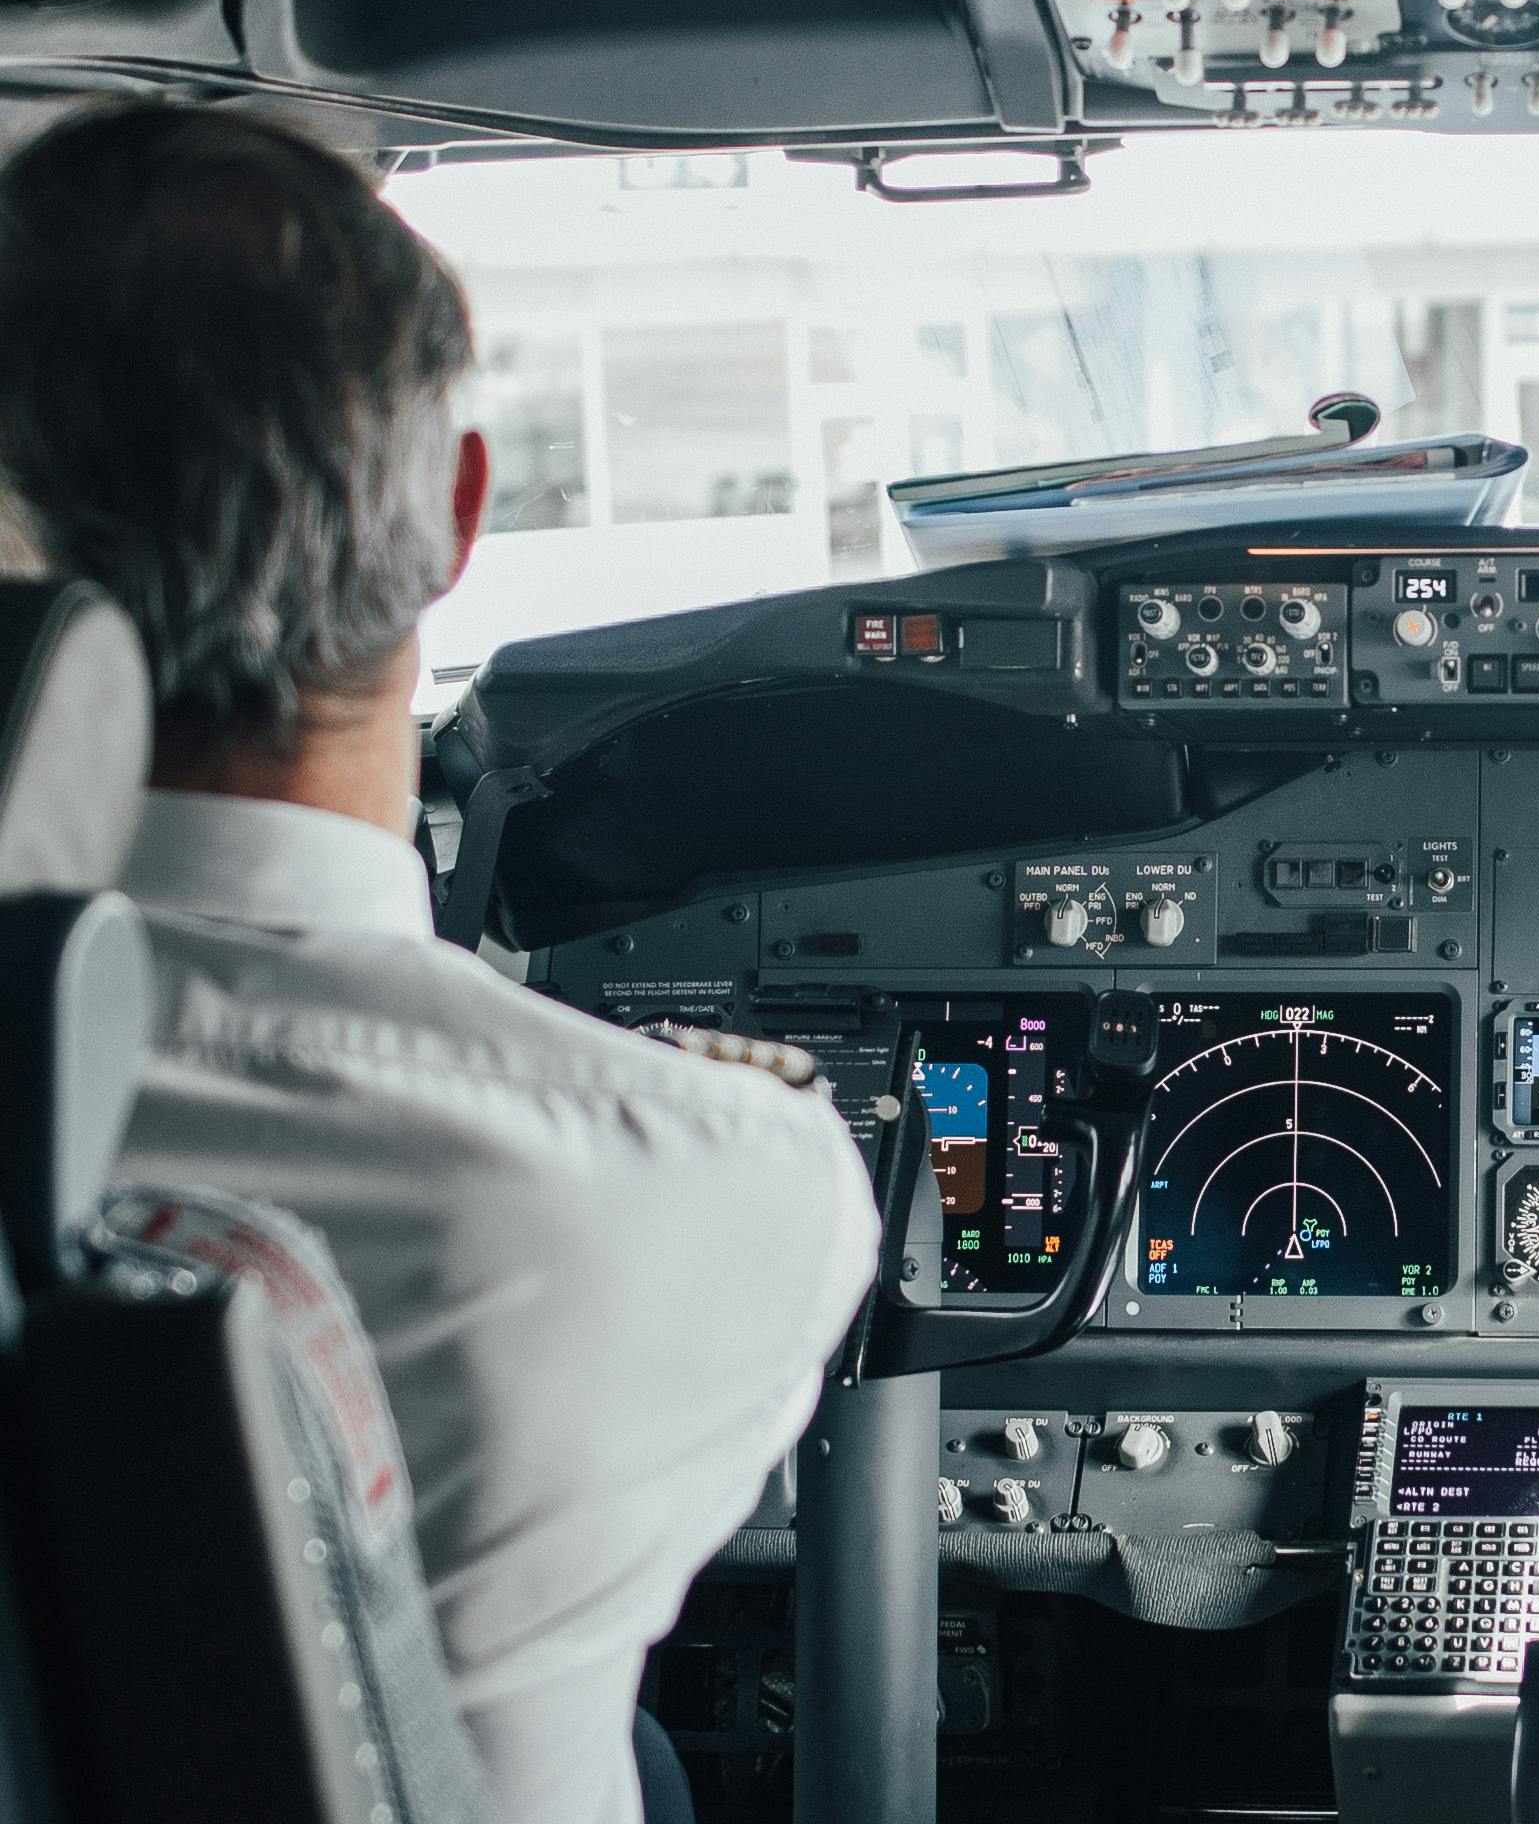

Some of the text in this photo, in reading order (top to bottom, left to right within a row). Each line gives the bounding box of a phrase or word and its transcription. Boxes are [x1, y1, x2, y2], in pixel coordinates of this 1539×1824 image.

[1406, 578, 1447, 599] 254
[865, 619, 885, 629] FIRE
[1423, 841, 1458, 851] LIGHTS
[1431, 854, 1449, 862] TEST
[1026, 866, 1051, 876] MAIN
[1053, 866, 1088, 876] PANEL
[1136, 865, 1192, 876] LOWER DU
[1055, 884, 1080, 892] NORM
[1151, 883, 1176, 892] NORM
[1019, 893, 1048, 902] OUTBD
[1088, 893, 1107, 902] ENG
[1125, 892, 1144, 901] ENG
[1184, 892, 1197, 901] ND
[1366, 893, 1384, 901] TEST
[1088, 901, 1102, 910] PRI
[1095, 917, 1113, 925] PFD
[1085, 942, 1104, 951] MFD
[1260, 1007, 1334, 1020] HDG 022 MAG
[1020, 1018, 1046, 1031] 8000
[948, 1106, 958, 1114] 10
[946, 1166, 956, 1175] 10
[945, 1196, 956, 1205] 20
[956, 1240, 980, 1250] 1800
[1149, 1239, 1174, 1251] TCAS
[1007, 1253, 1031, 1263] 1010
[1149, 1250, 1168, 1261] OFF
[1402, 1264, 1432, 1275] VOR 2
[1269, 1286, 1288, 1295] 1.00
[1300, 1286, 1318, 1295] 0.03
[1117, 1415, 1175, 1424] BACKGROUND
[1447, 1412, 1484, 1422] RTE 1
[1035, 1418, 1049, 1427] DU
[1412, 1421, 1455, 1429] ORIGIN
[1431, 1436, 1467, 1444] ROUTE
[1408, 1450, 1451, 1459] RUNWAY
[1101, 1464, 1118, 1473] OFF
[1230, 1464, 1250, 1473] OFF
[1027, 1479, 1041, 1489] DU
[1440, 1487, 1470, 1497] DEST
